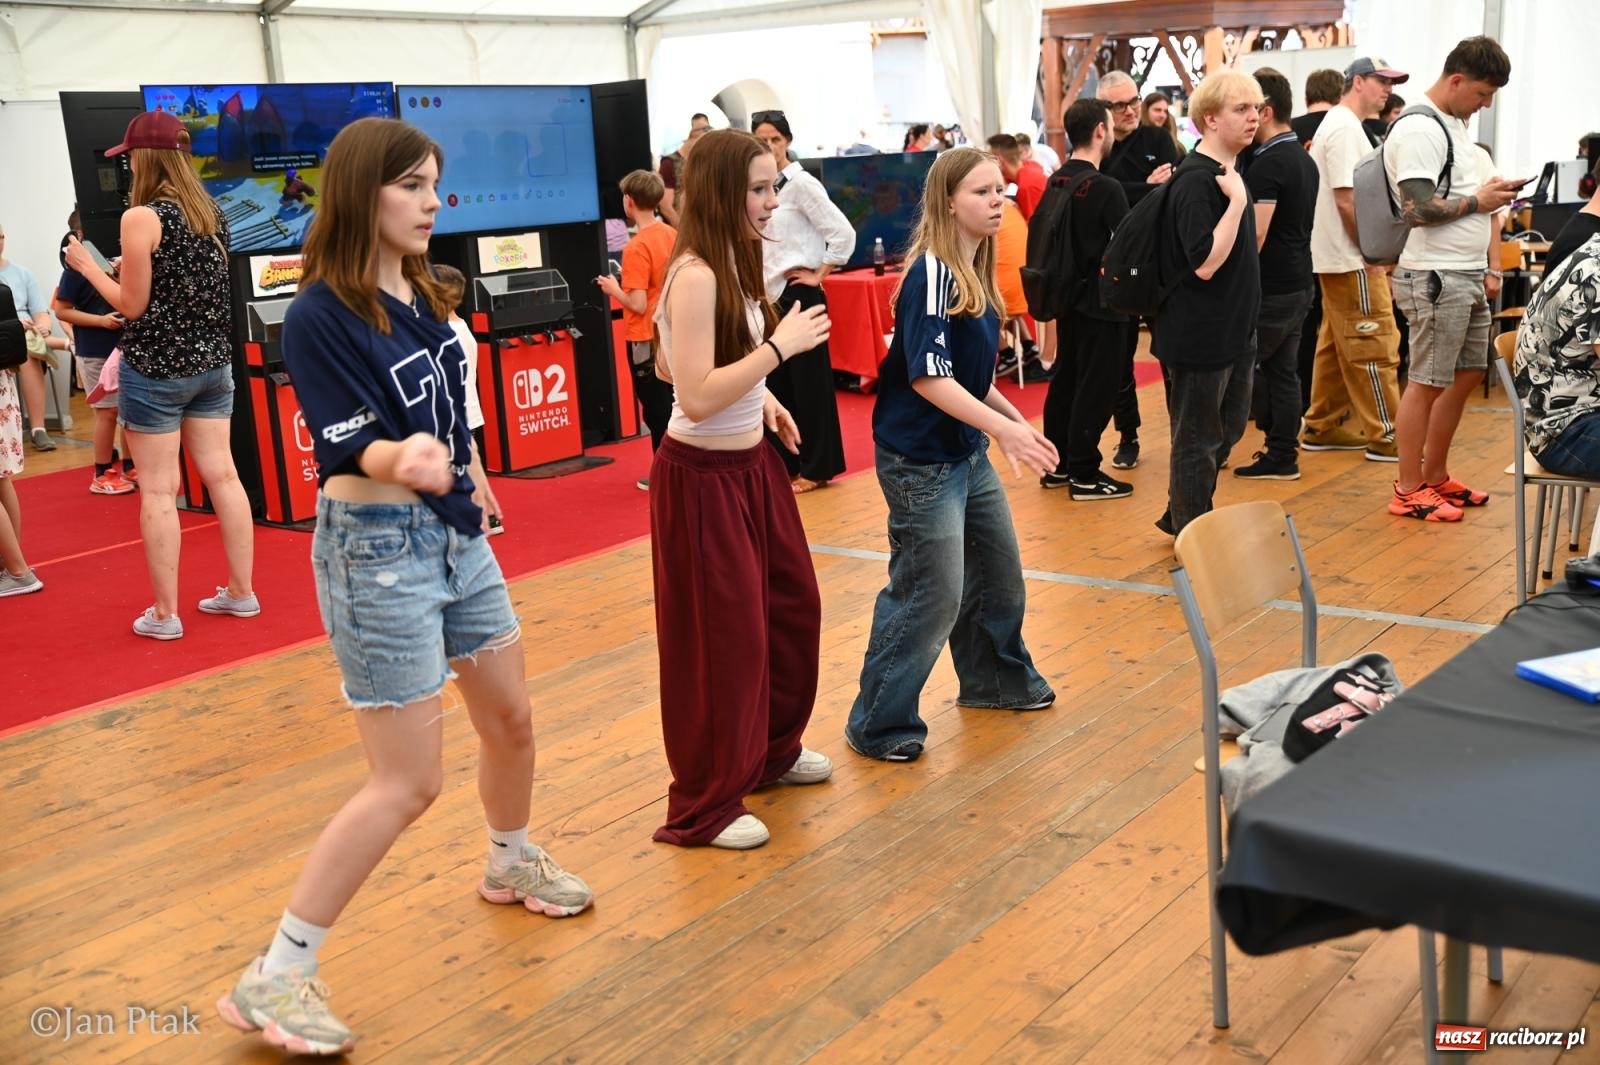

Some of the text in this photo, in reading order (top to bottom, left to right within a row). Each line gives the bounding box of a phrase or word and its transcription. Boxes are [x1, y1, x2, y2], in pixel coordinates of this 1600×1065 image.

[544, 363, 568, 404] 2
[518, 406, 568, 423] NINTENDO
[519, 414, 569, 436] SWITCH
